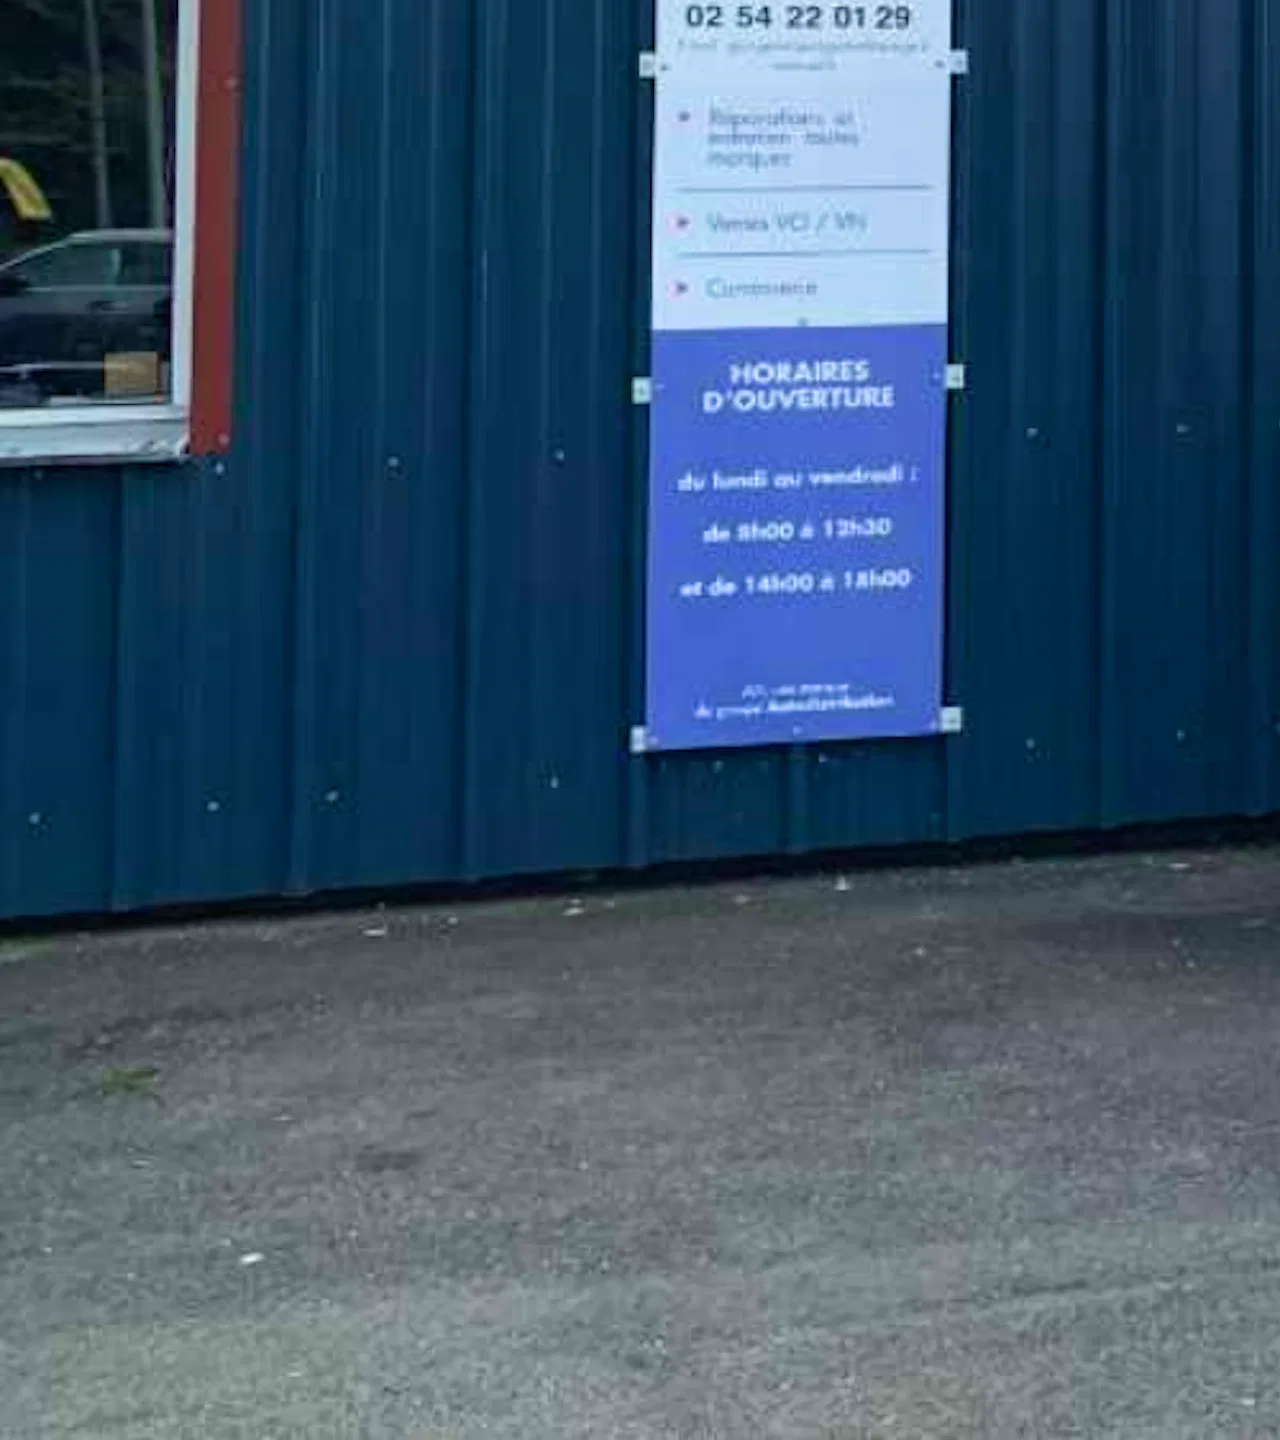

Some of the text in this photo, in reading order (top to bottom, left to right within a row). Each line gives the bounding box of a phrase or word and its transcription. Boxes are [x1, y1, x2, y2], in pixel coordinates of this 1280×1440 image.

[685, 6, 911, 30] 02 54 22 01 29
[730, 359, 870, 384] HORAIRES
[703, 385, 895, 413] D'OUVERTURE
